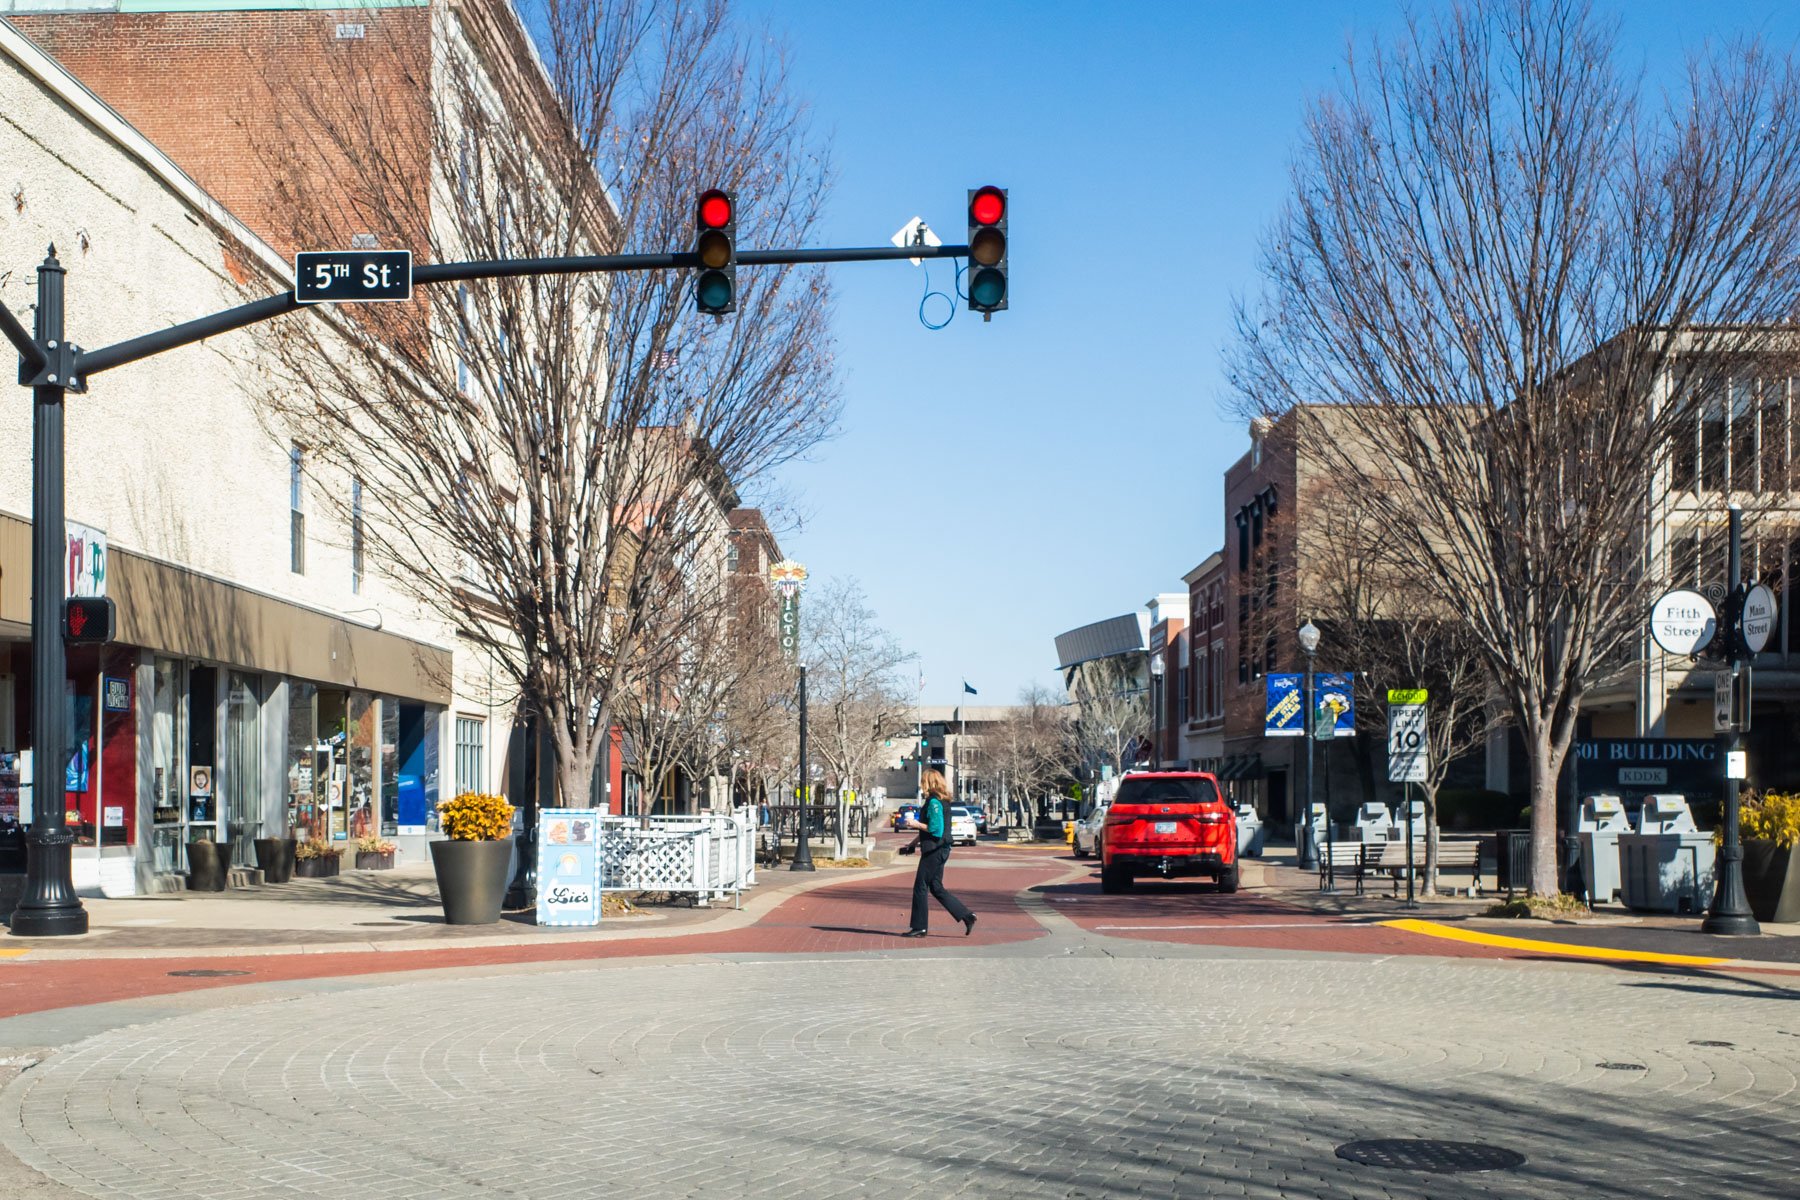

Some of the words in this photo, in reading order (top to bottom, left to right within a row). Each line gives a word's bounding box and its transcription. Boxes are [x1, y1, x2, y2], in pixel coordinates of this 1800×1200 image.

[315, 264, 350, 289] 5TH
[362, 263, 391, 288] St
[1667, 607, 1701, 619] Fifth
[1749, 604, 1765, 617] Main
[1663, 625, 1705, 637] Street
[1747, 622, 1768, 636] Street
[1717, 672, 1730, 688] ONE
[109, 681, 126, 695] BUD
[107, 694, 129, 708] LIGHT
[1392, 692, 1424, 700] SCHOOL
[1717, 691, 1730, 706] WAY
[1392, 709, 1424, 717] SPEED
[1395, 719, 1420, 728] LIMIT
[1396, 731, 1420, 748] 10
[1610, 743, 1715, 760] BUILDING
[1624, 771, 1662, 782] KDDK
[547, 887, 589, 905] Lic's
